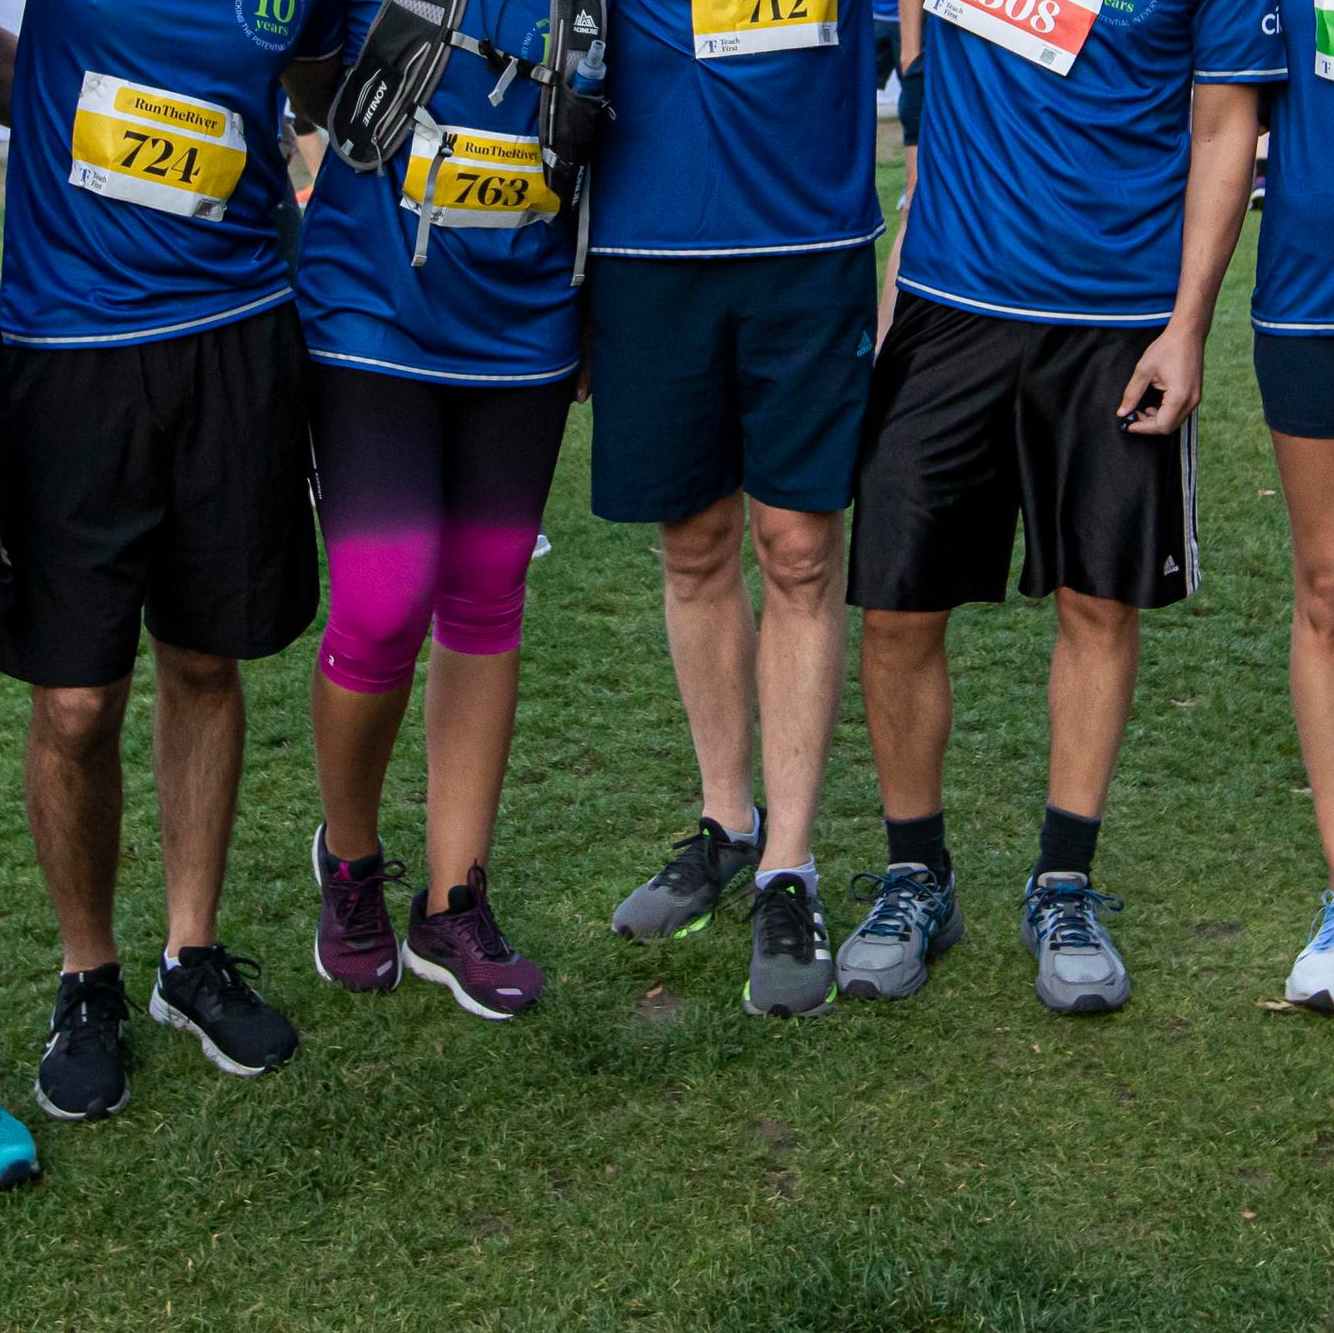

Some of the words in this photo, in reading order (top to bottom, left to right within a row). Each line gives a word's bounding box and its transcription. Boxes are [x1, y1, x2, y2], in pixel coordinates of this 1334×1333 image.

[255, 20, 289, 36] years
[120, 130, 202, 184] 724
[454, 172, 529, 207] 763
